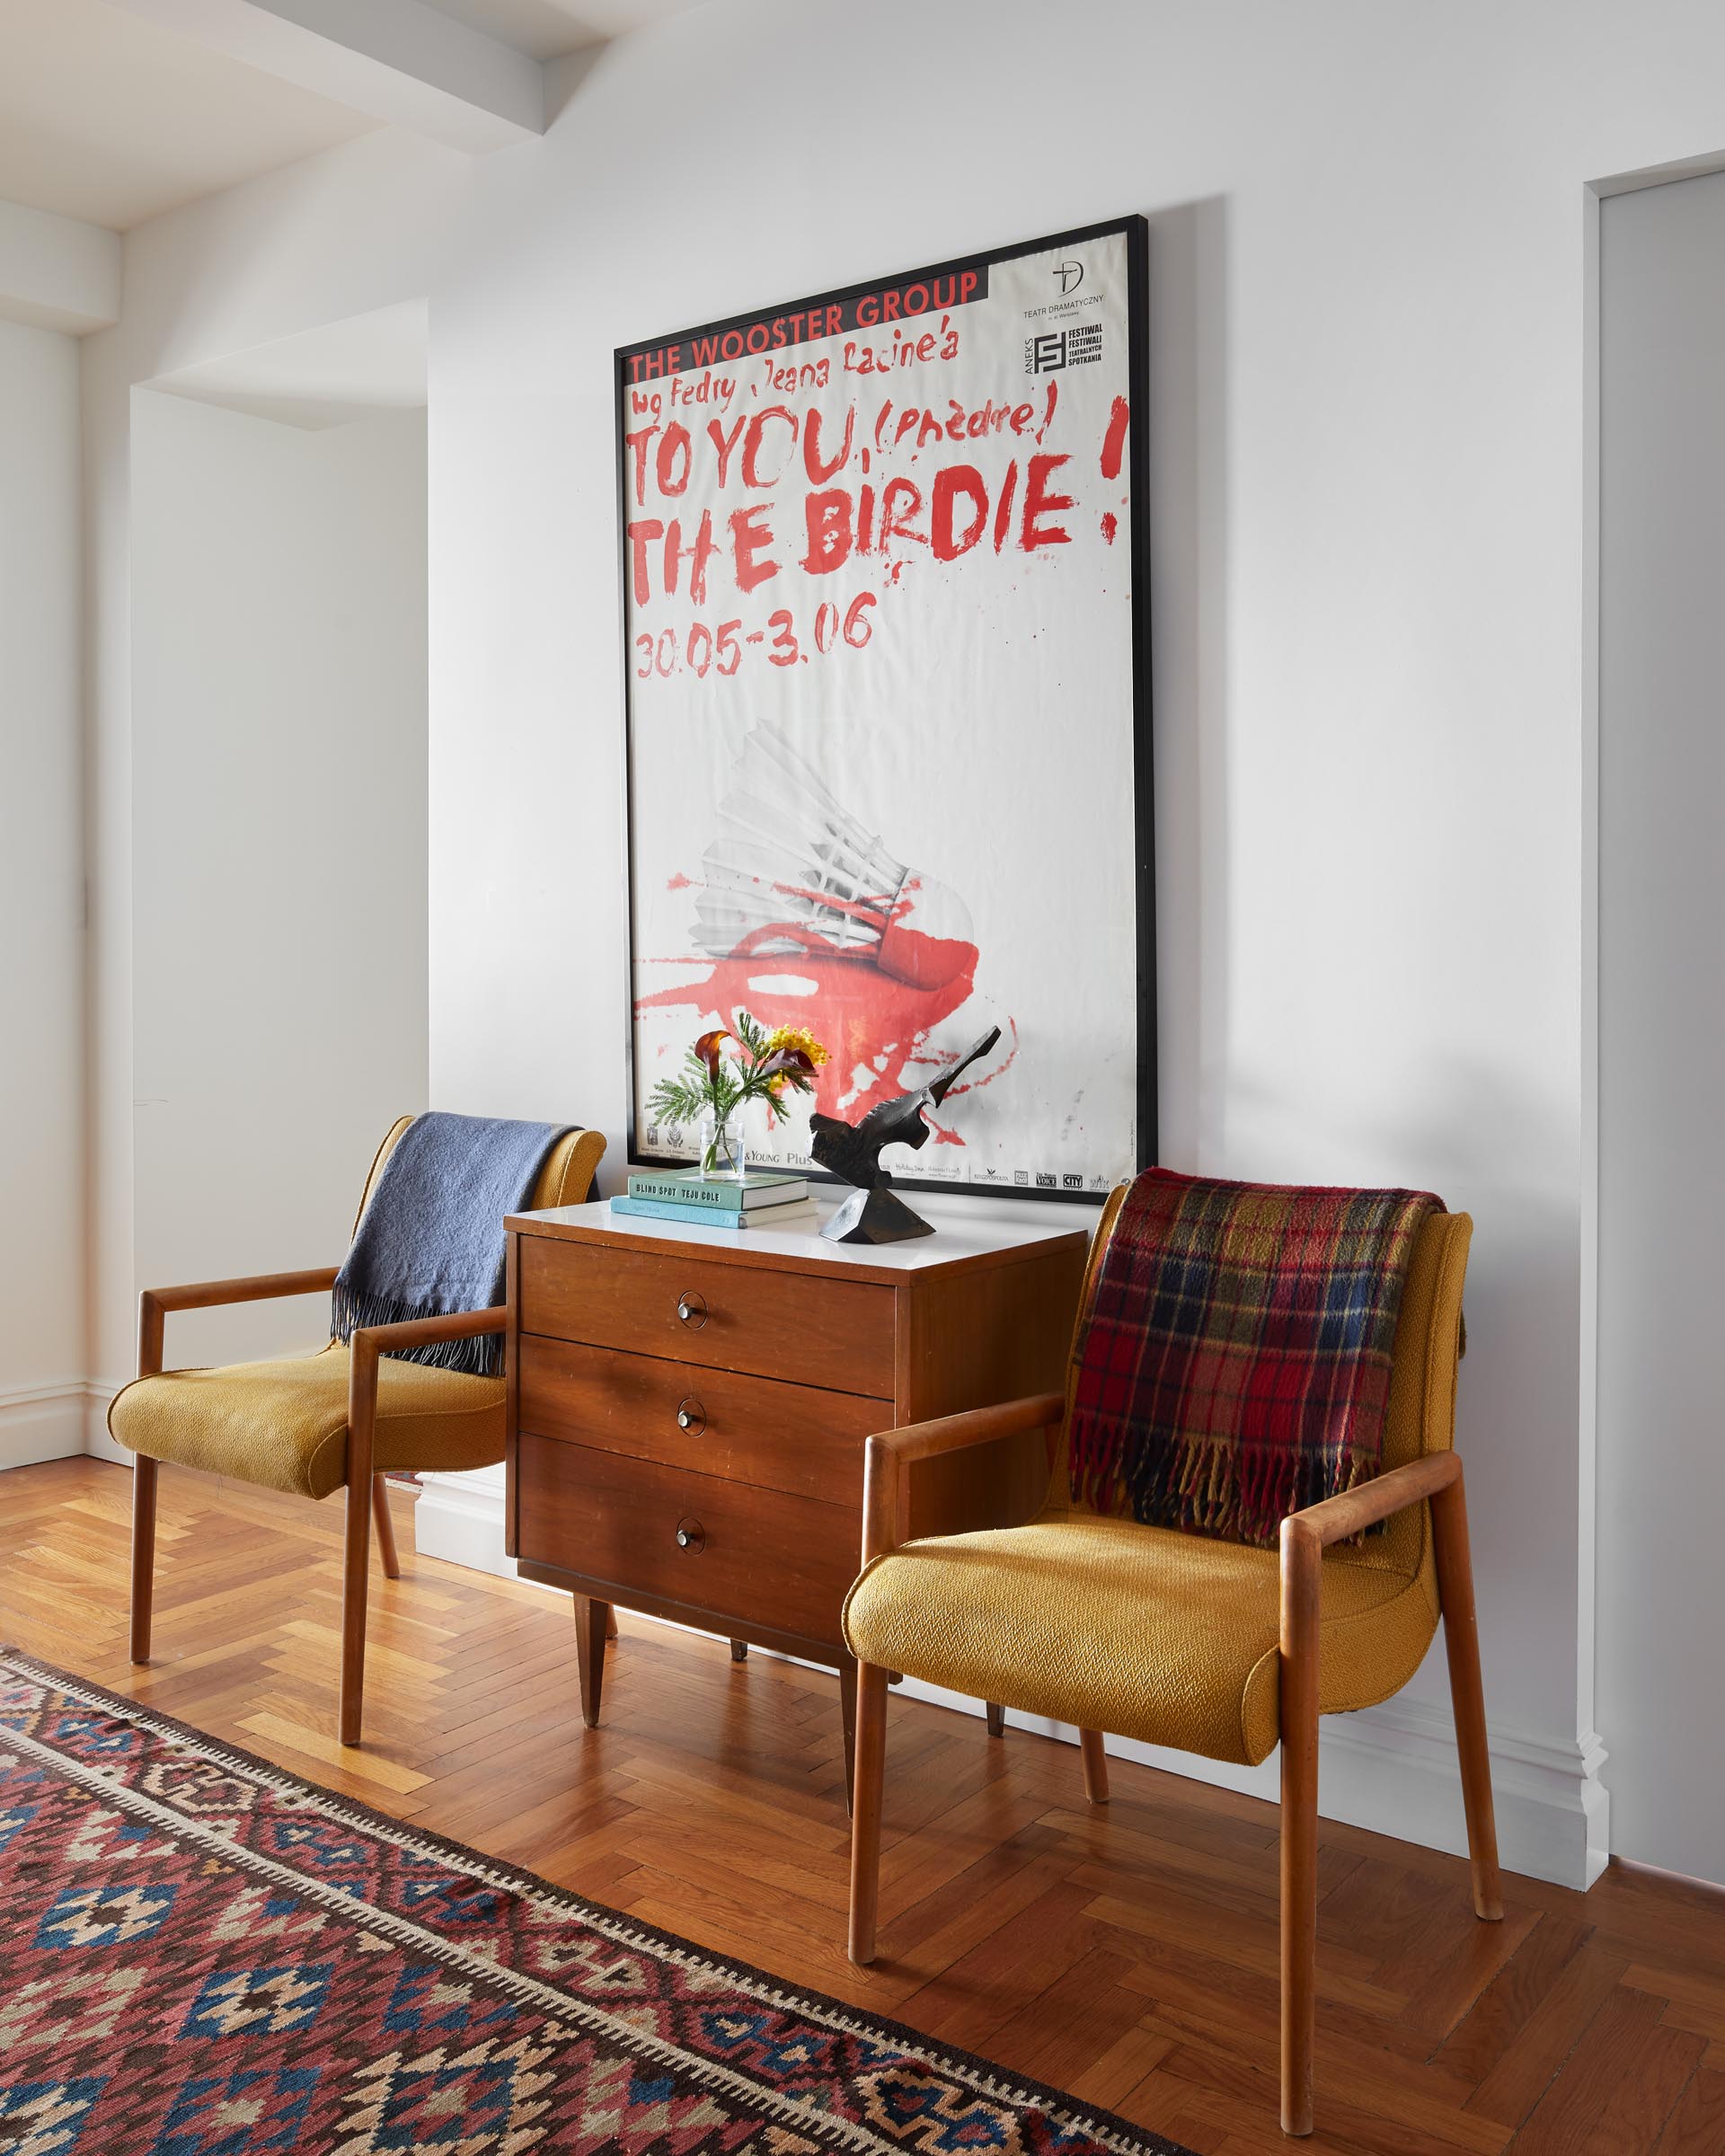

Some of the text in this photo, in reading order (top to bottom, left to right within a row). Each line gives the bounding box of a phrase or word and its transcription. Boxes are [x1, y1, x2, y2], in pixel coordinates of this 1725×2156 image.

[1024, 307, 1047, 319] TEATR
[1048, 295, 1104, 314] DRAMATYCZNY
[630, 271, 978, 383] THE WOOSTER GROUP
[1069, 323, 1103, 340] FESTIWAL
[1069, 335, 1102, 349] FESTIWALI
[1024, 338, 1034, 375] ANEKS
[1069, 345, 1102, 358] TEATRALNYCH
[1069, 354, 1102, 367] SPOTKANIA
[626, 420, 692, 506] TO
[628, 502, 783, 608] THE
[787, 1153, 813, 1165] Plus
[1037, 1176, 1057, 1185] VOICE
[1064, 1176, 1082, 1186] CITY
[636, 1183, 720, 1202] BLIND SPOT TEJU COLE
